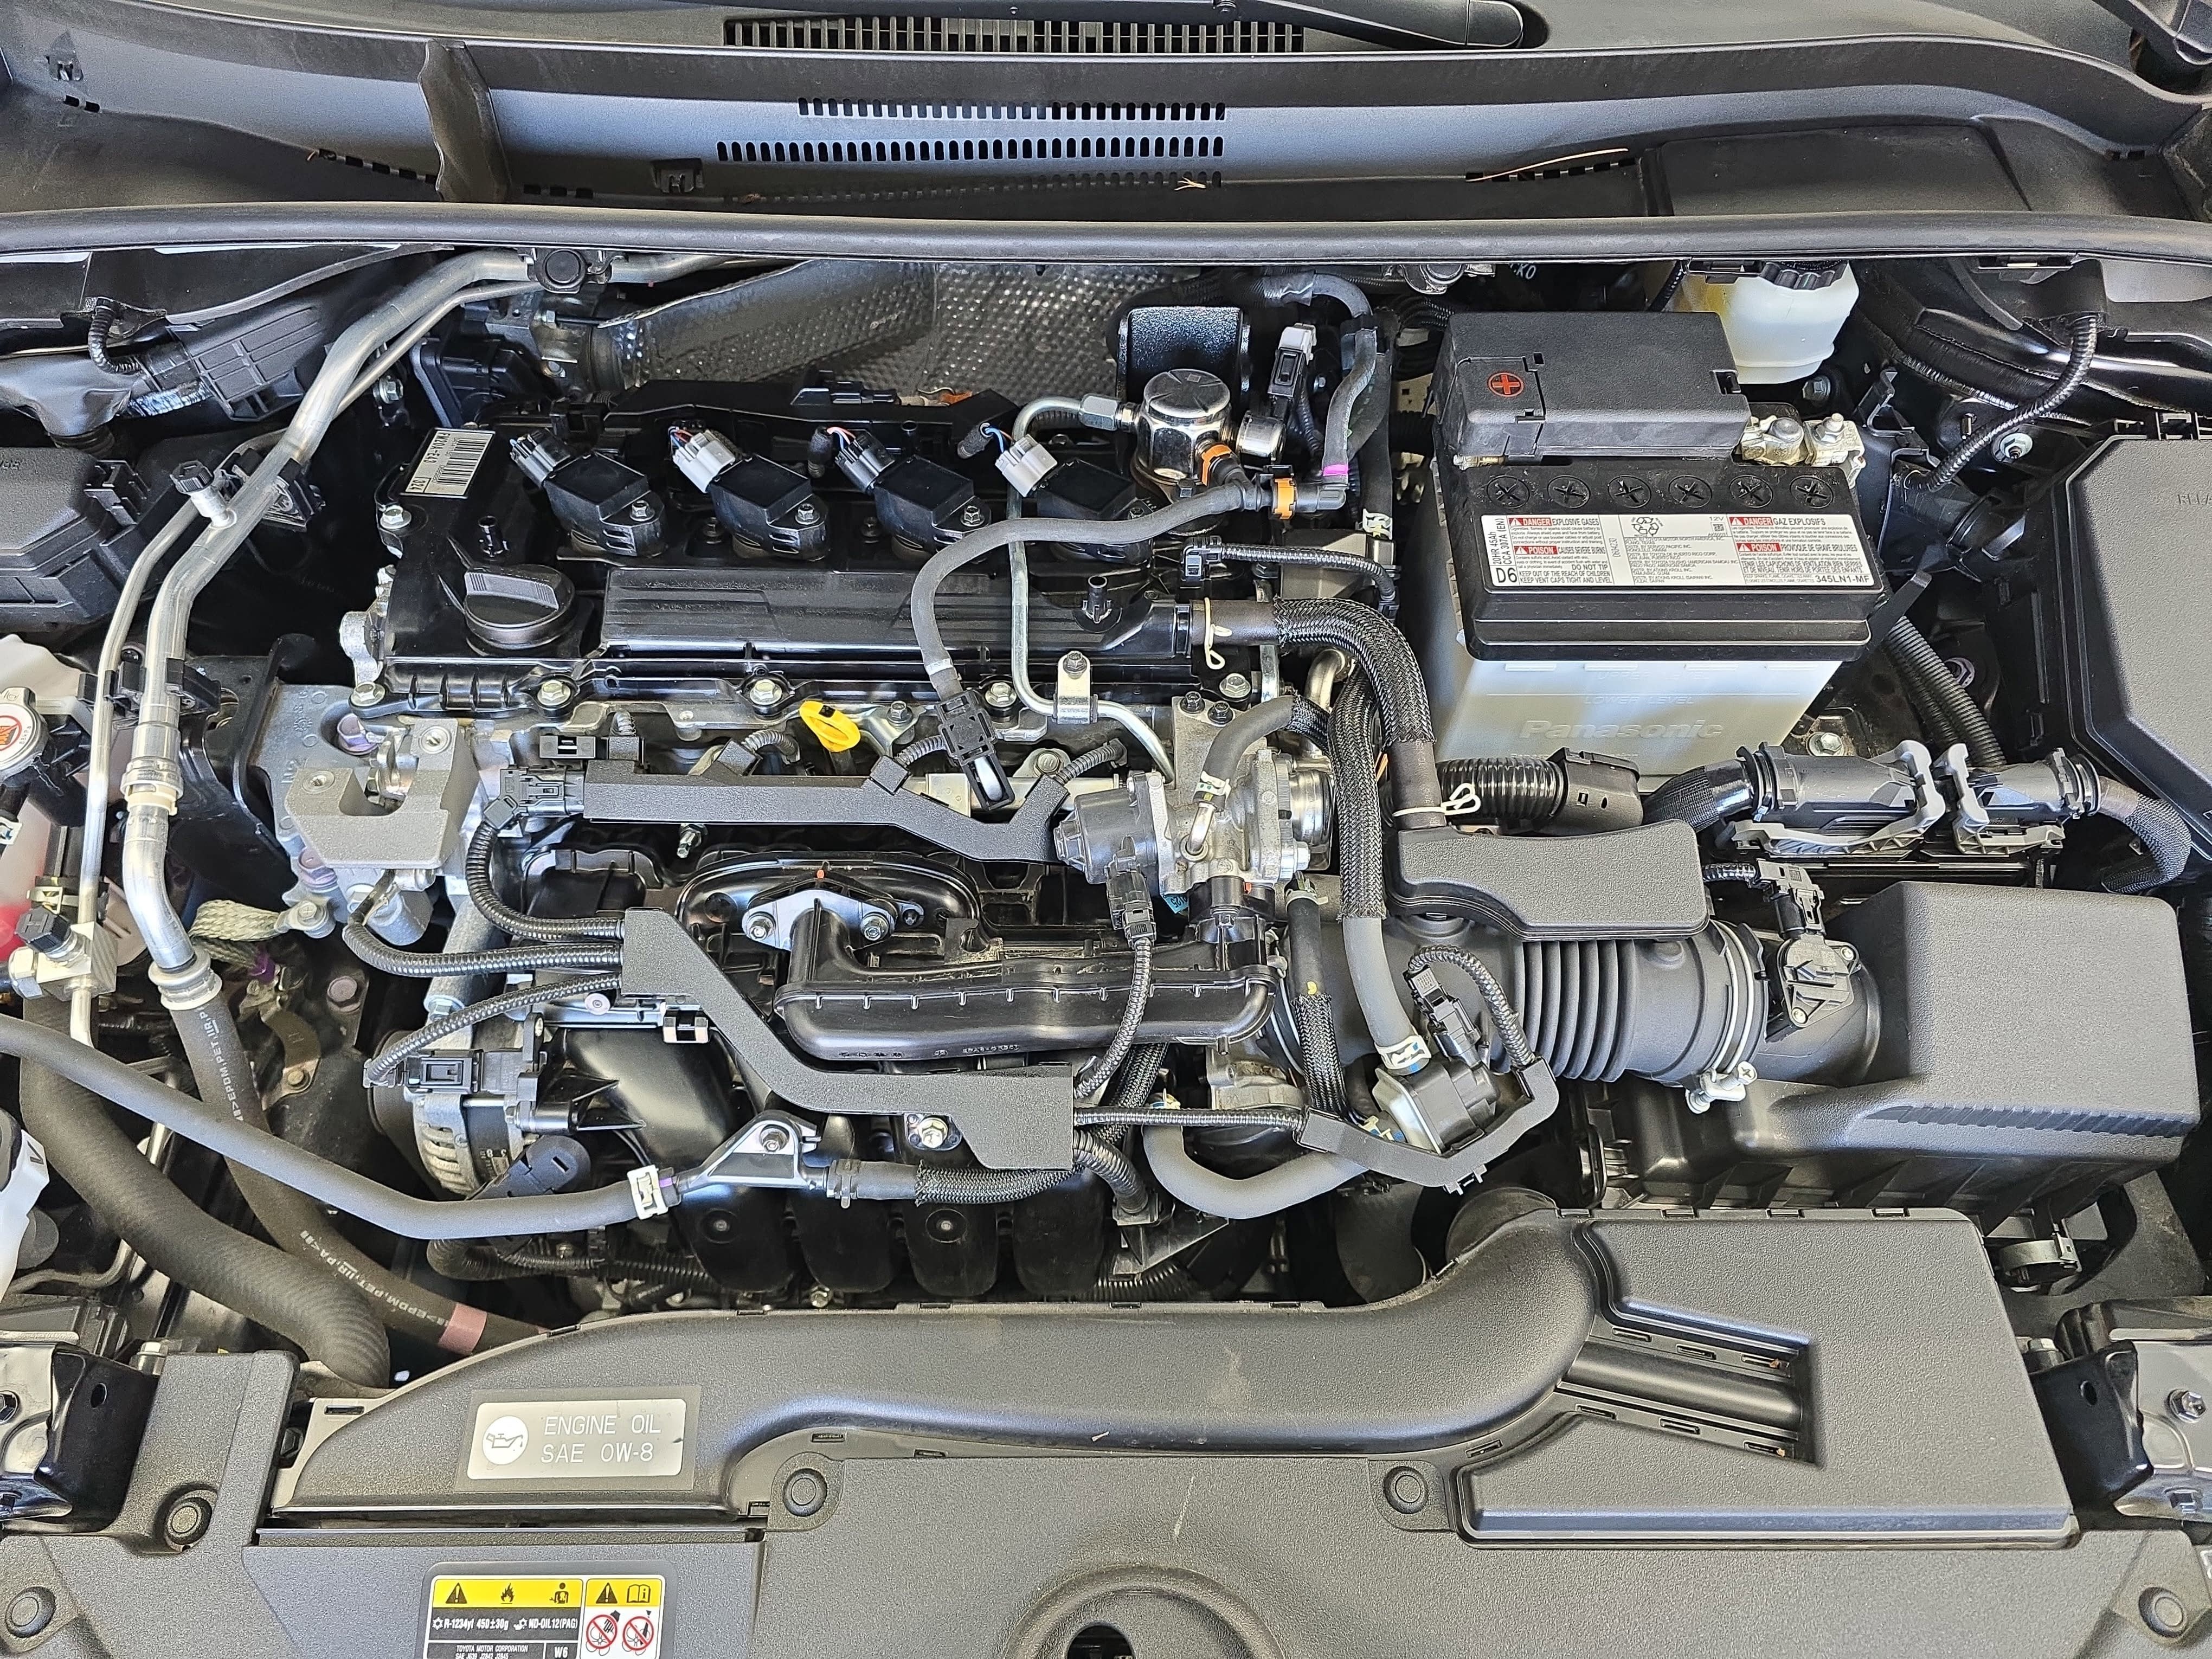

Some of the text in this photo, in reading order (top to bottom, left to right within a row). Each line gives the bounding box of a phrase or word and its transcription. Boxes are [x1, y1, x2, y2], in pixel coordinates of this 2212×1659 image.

[410, 480, 426, 490] 324
[1488, 531, 1502, 564] 20HR 45Ah
[1495, 518, 1513, 564] CCA 307A (EN)
[1496, 567, 1517, 583] D6
[1583, 696, 1695, 705] LOWER LEVEL
[1519, 719, 1724, 739] Panasonic
[544, 1414, 661, 1435] ENGINE OIL
[541, 1442, 654, 1463] SAE 0W-8
[443, 1618, 578, 1631] R-1234yf 450±30g ND-OIL12(PAG)
[554, 1647, 568, 1658] W6
